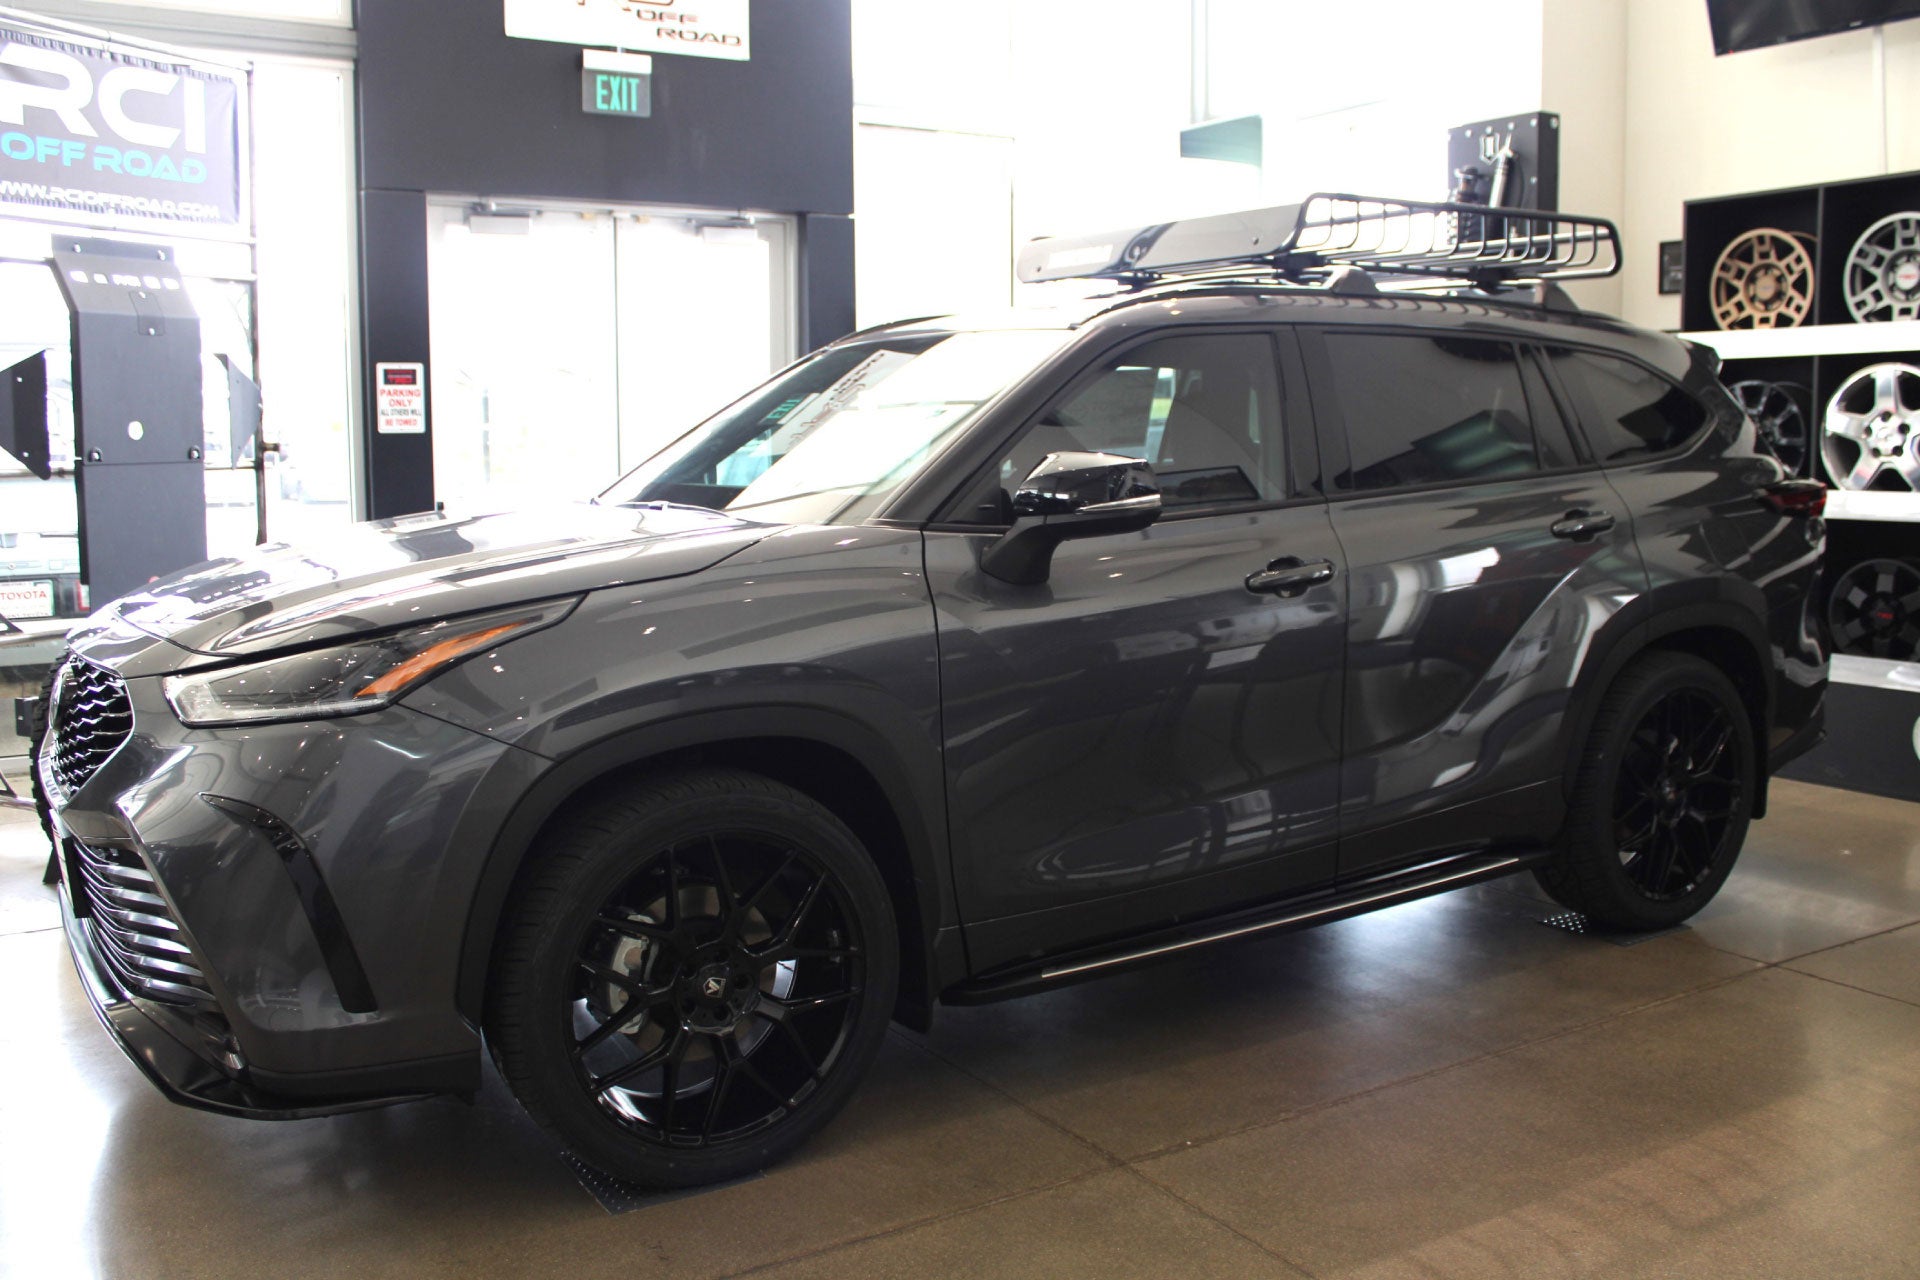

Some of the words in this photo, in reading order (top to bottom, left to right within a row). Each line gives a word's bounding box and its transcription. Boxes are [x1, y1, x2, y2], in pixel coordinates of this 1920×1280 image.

[636, 9, 698, 24] OFF
[656, 27, 742, 47] ROAD
[0, 42, 206, 154] RCI
[596, 75, 639, 112] EXIT
[1, 132, 86, 167] OFF
[93, 146, 207, 184] ROAD
[380, 389, 421, 397] PARKING
[389, 399, 412, 407] ONLY
[0, 590, 47, 600] TOYOTA
